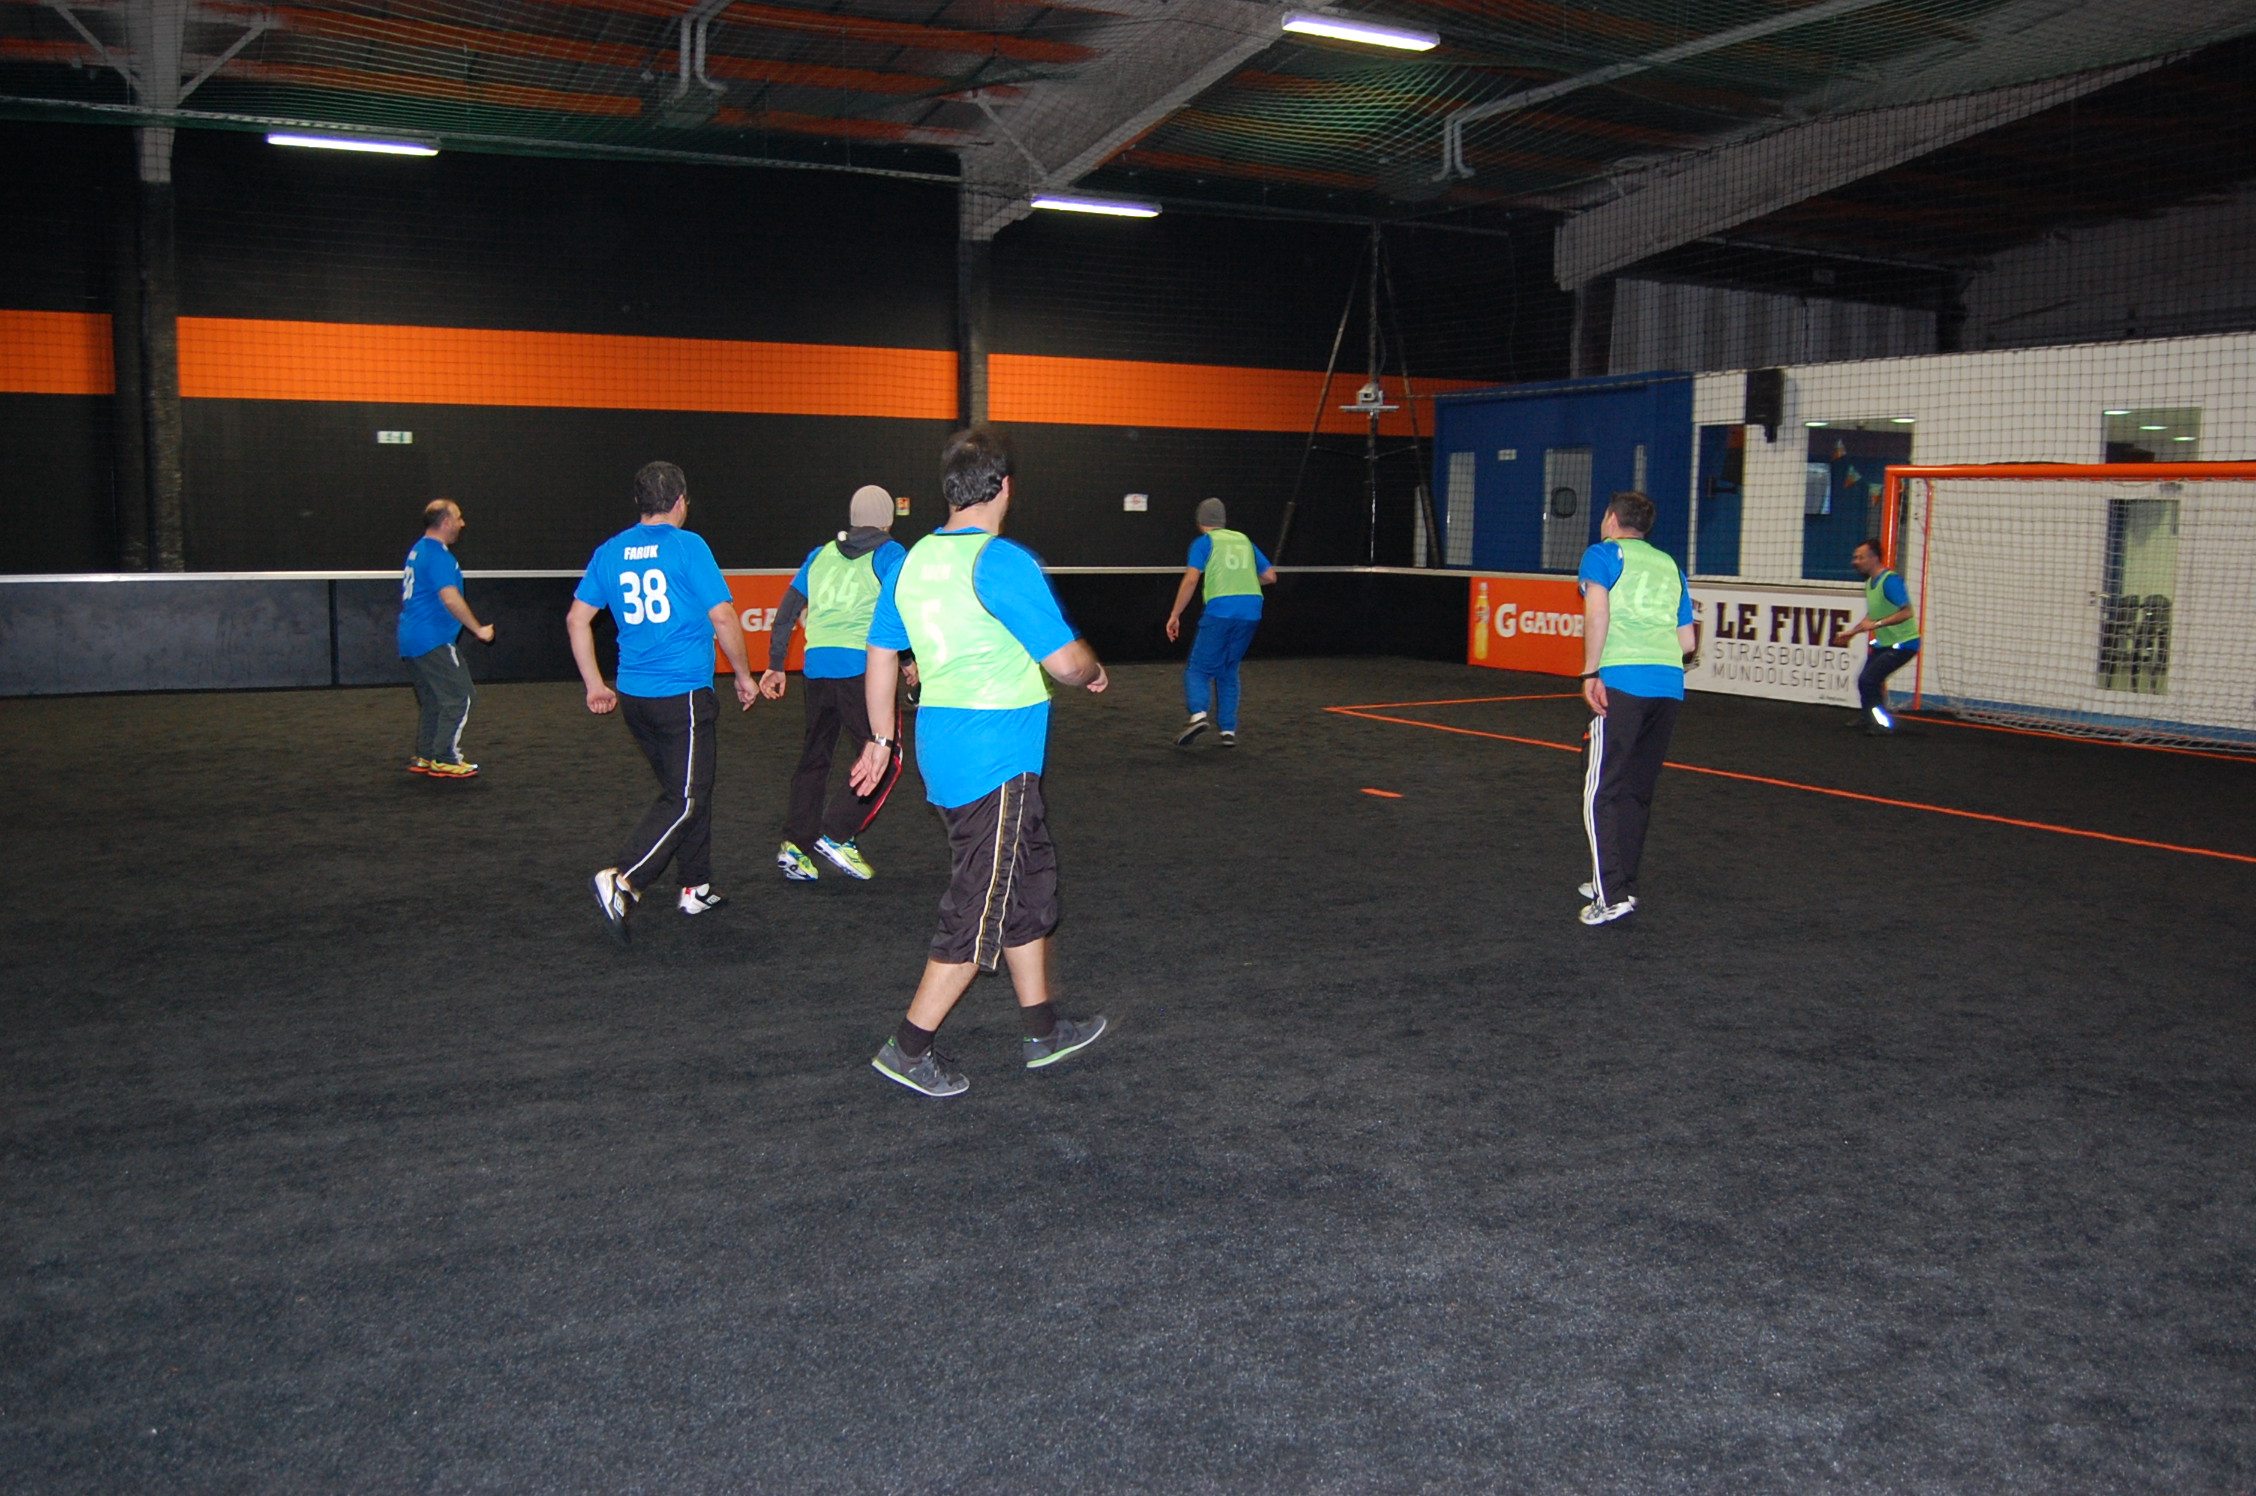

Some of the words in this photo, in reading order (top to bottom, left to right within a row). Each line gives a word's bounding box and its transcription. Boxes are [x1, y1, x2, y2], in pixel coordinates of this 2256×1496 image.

[624, 545, 659, 560] FARUK
[1225, 544, 1250, 570] 67
[619, 568, 671, 625] 38
[817, 566, 860, 612] 64
[1715, 602, 1758, 640] LE
[1770, 605, 1851, 648] FIVE
[1714, 641, 1850, 671] STRASBOURG
[1713, 662, 1850, 692] MUNDOLSHEIM
